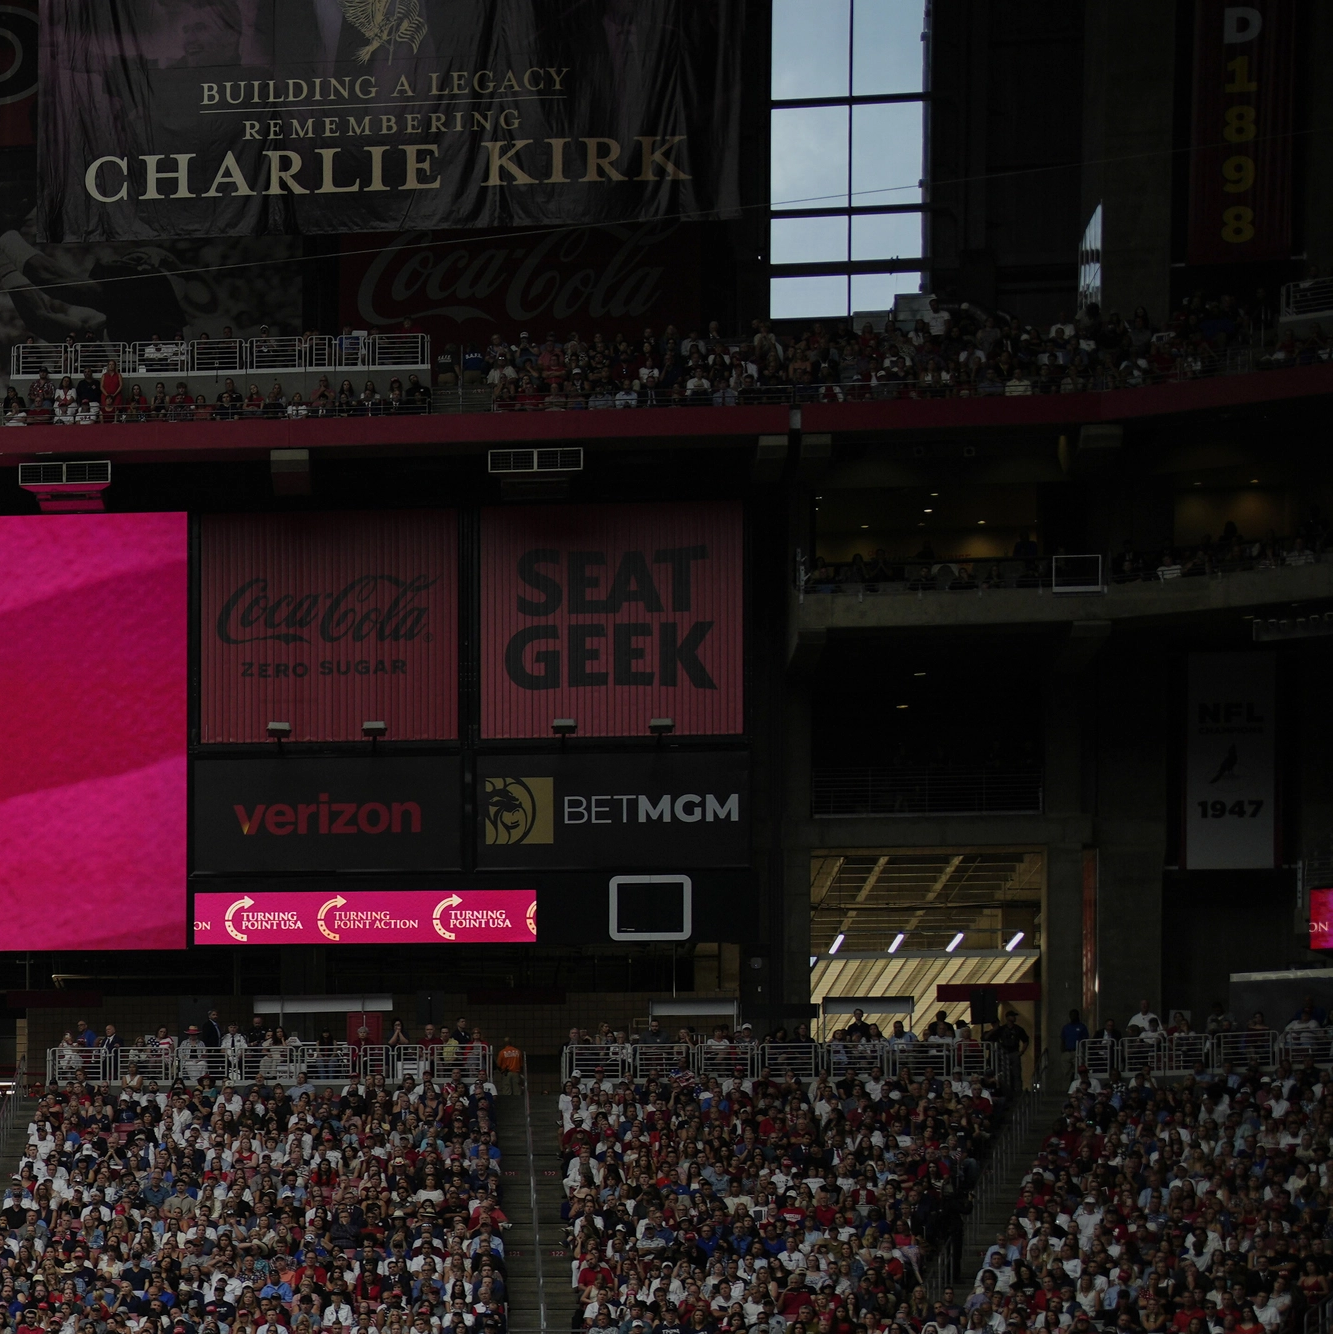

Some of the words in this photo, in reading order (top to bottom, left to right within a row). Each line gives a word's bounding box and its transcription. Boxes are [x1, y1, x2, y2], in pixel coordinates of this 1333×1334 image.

[199, 75, 377, 106] BUILDING
[394, 73, 415, 95] A
[428, 67, 570, 95] LEGACY
[243, 109, 522, 140] REMEMBERING
[1220, 55, 1258, 243] 1898
[84, 143, 442, 202] CHARLIE
[481, 135, 693, 187] KIRK
[516, 544, 708, 617] SEAT
[504, 620, 718, 691] GEEK
[240, 660, 309, 679] ZERO
[318, 659, 408, 677] SUGAR
[1198, 703, 1264, 723] NFL
[233, 793, 422, 835] verizon
[563, 793, 740, 825] BETMGM
[1197, 800, 1264, 818] 1947
[241, 912, 297, 922] TURNING
[242, 920, 279, 931] POINT
[281, 919, 303, 930] USA
[334, 911, 390, 921] TURNING
[334, 920, 370, 930] POINT
[373, 919, 418, 929] ACTION
[449, 910, 506, 921] TURNING
[450, 919, 487, 929] POINT
[489, 918, 511, 928] USA
